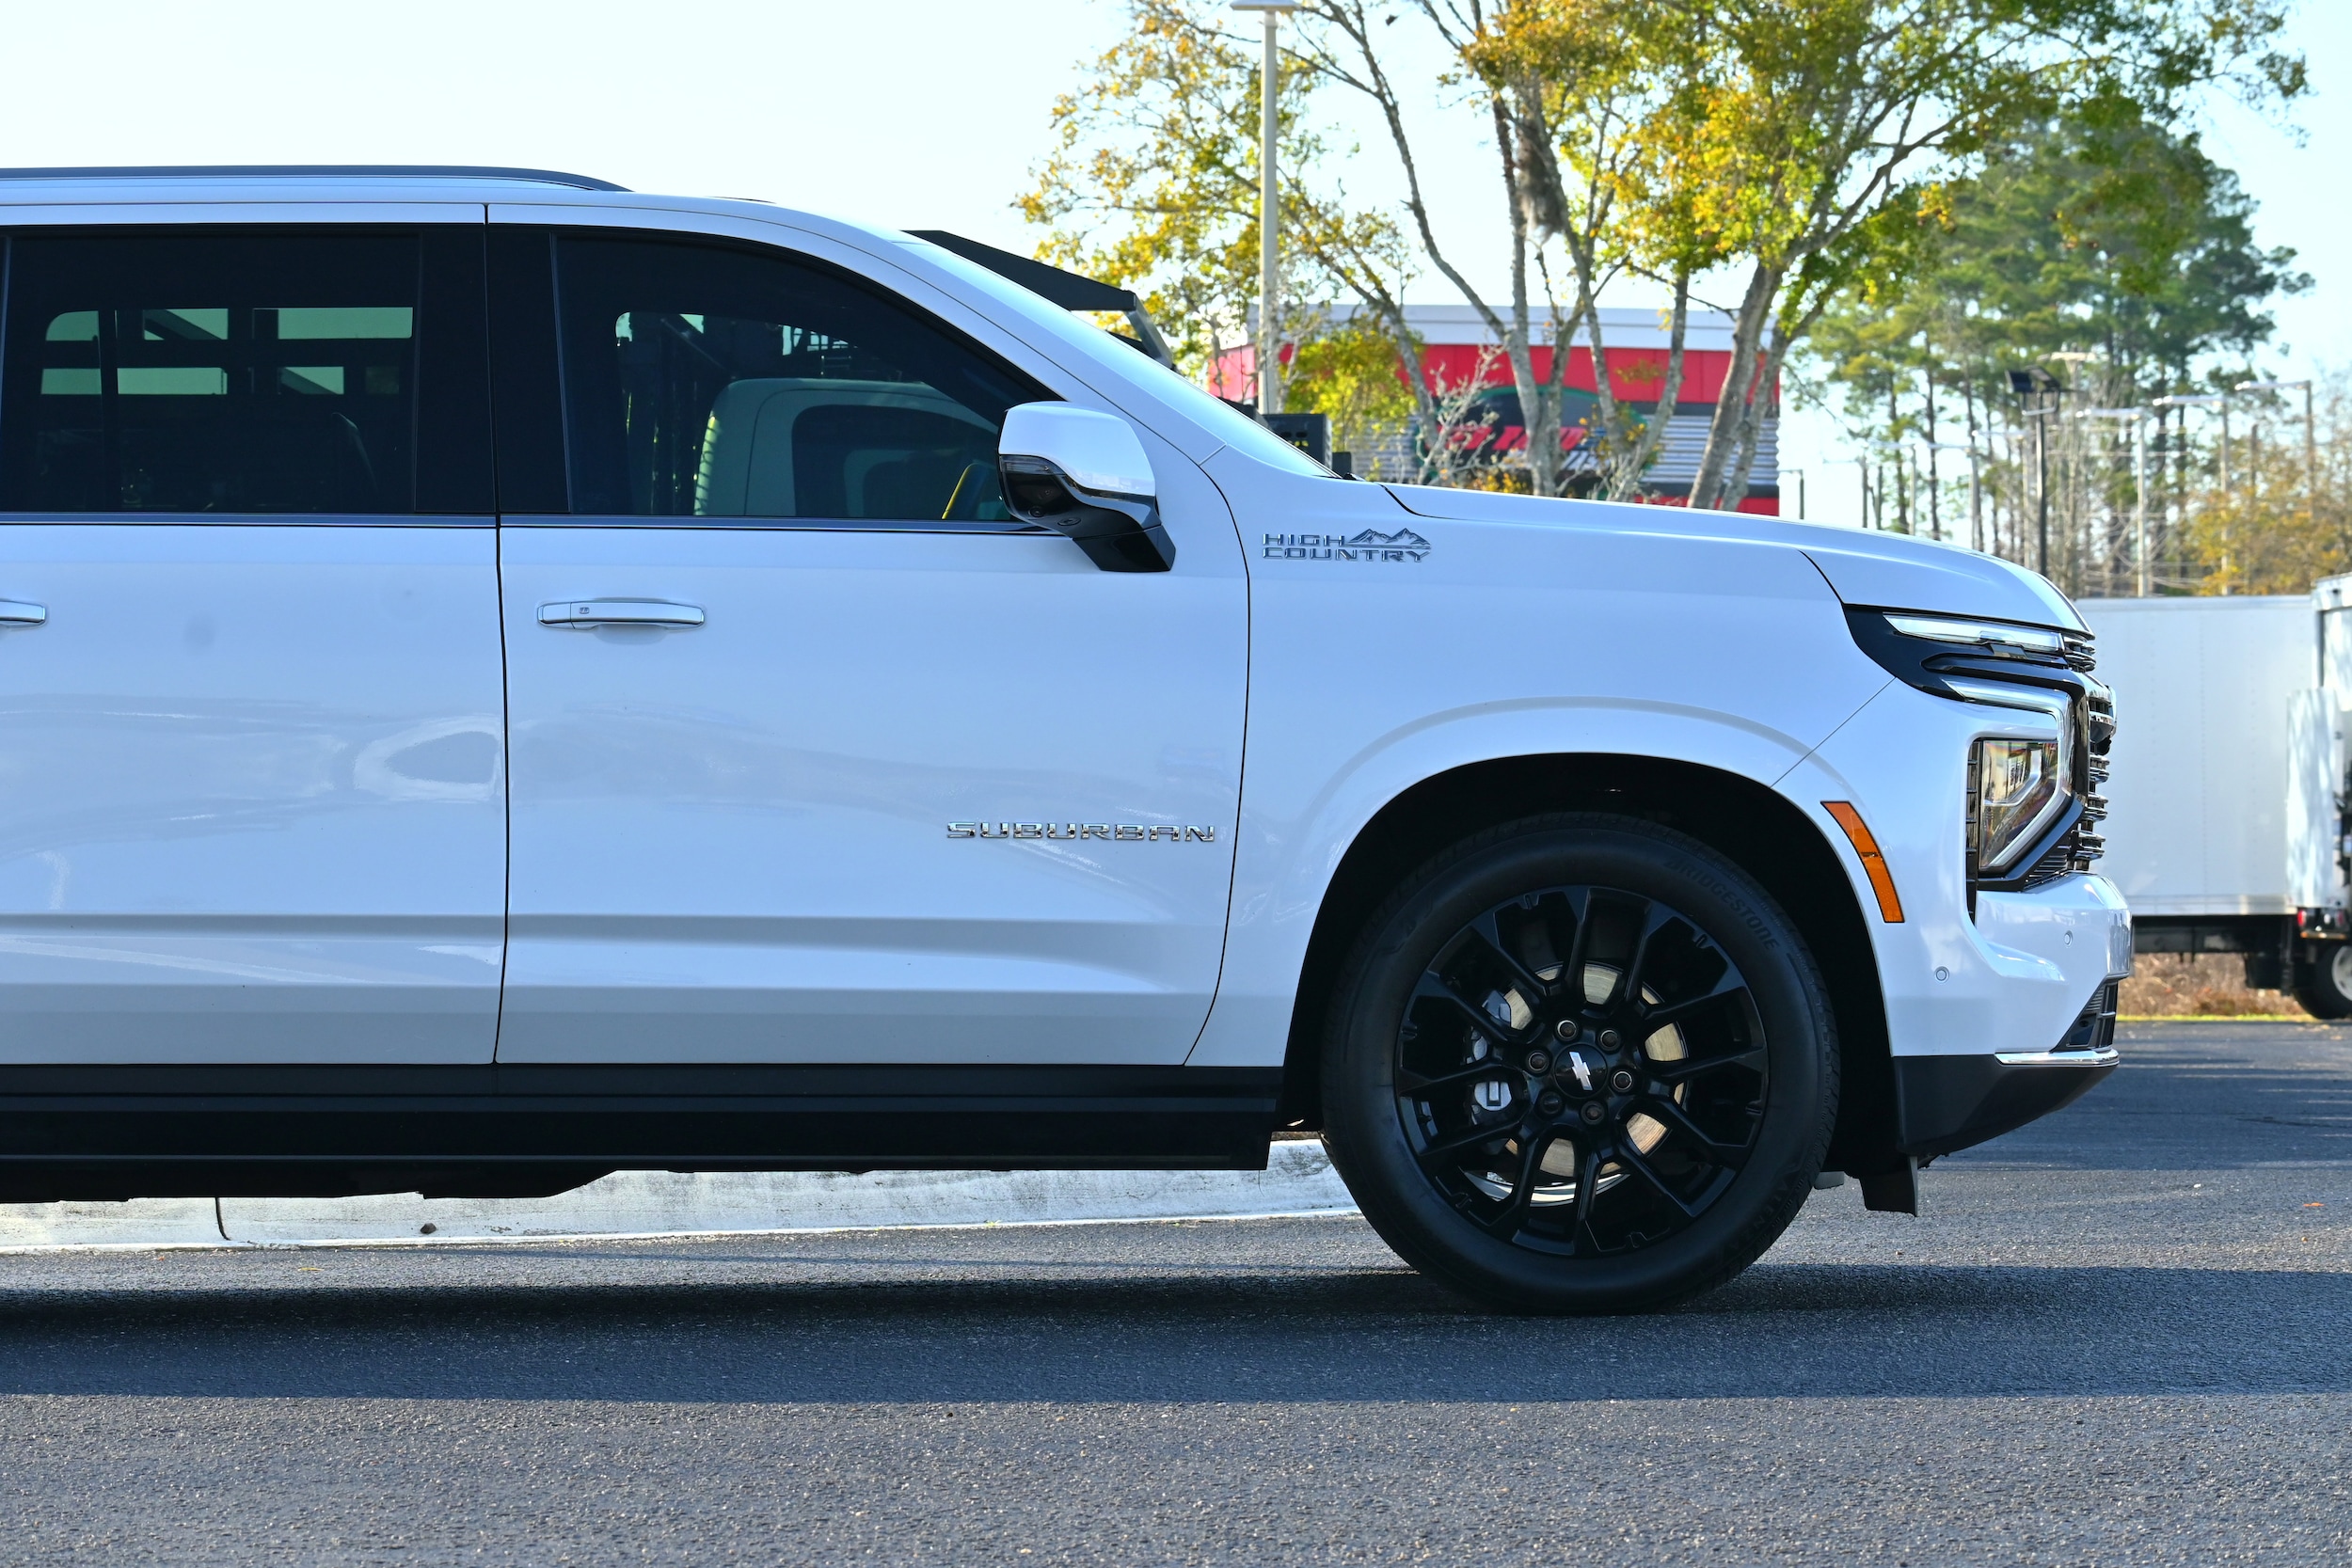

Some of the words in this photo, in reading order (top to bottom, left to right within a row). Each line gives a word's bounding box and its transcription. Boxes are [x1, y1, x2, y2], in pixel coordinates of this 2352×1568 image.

[1263, 533, 1345, 546] HIGH
[1263, 546, 1431, 562] COUNTRY
[947, 821, 1215, 842] SUBURBAN
[1663, 857, 1780, 950] BRIDGESTONE
